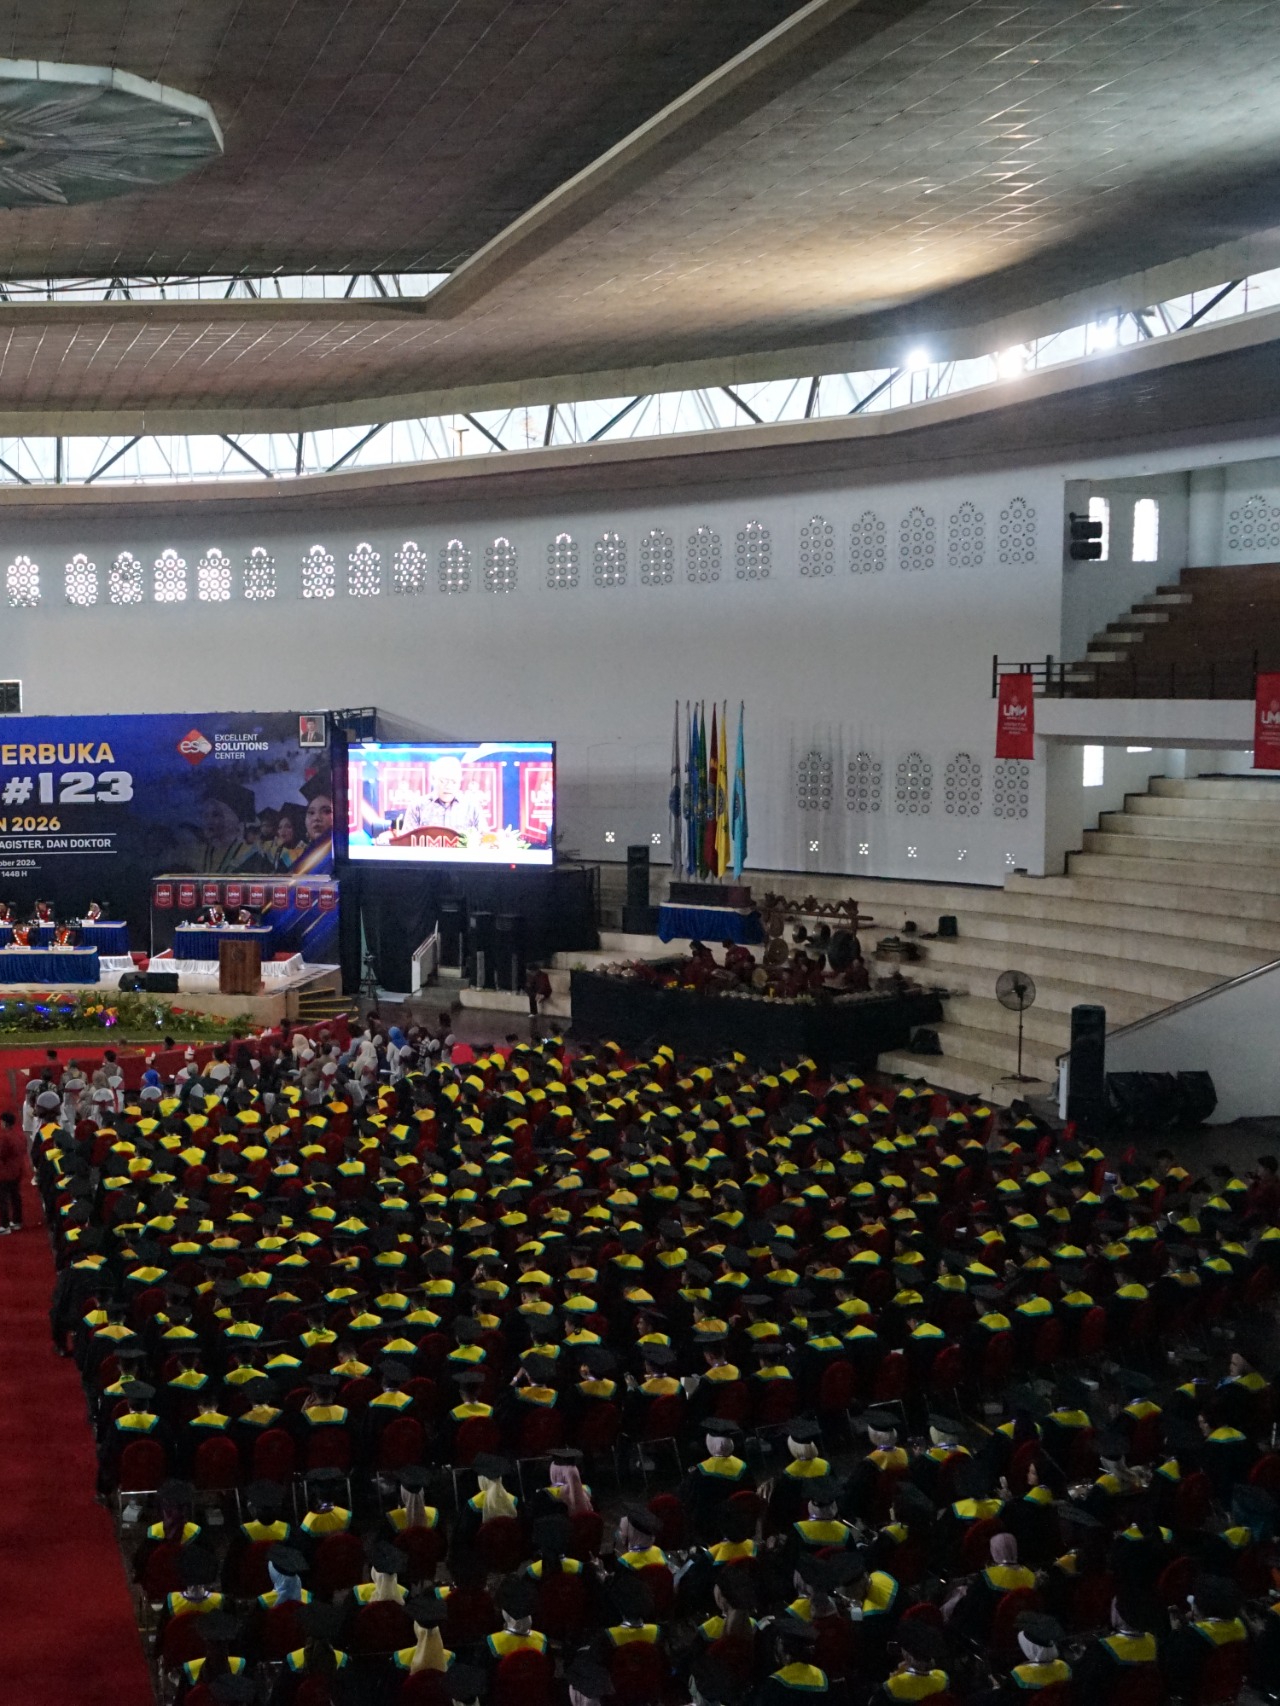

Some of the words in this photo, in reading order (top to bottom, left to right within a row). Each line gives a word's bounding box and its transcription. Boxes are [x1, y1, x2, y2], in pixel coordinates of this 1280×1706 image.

[214, 733, 258, 742] EXCELLENT
[214, 742, 269, 751] SOLUTIONS
[214, 752, 245, 760] CENTER
[2, 771, 134, 805] #123
[11, 816, 61, 832] 2026
[46, 839, 68, 848] DAN
[70, 838, 111, 848] DOKTOR
[16, 859, 36, 867] 2026
[1, 870, 20, 878] 1448
